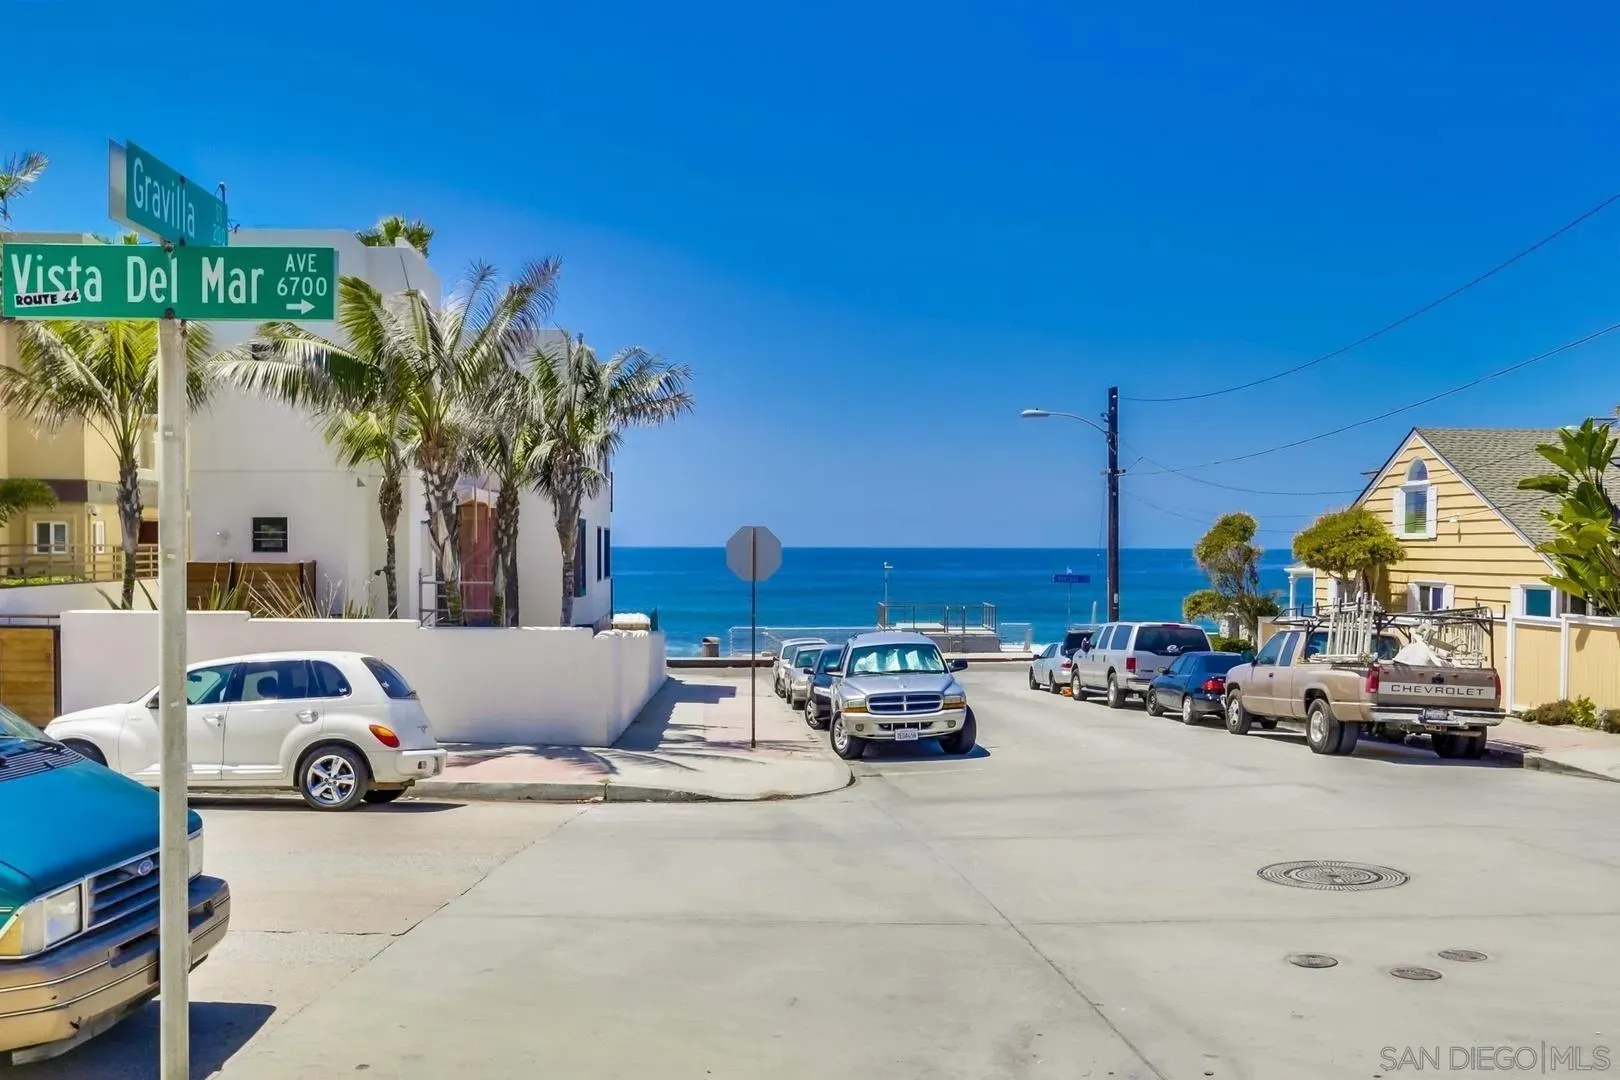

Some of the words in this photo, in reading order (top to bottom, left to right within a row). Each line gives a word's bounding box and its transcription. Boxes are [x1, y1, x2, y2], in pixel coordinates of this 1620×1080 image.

[133, 157, 195, 239] Gravilla
[284, 253, 317, 273] AVE
[10, 253, 102, 302] Vista
[126, 255, 178, 303] Del
[201, 256, 264, 304] Mar
[277, 277, 327, 297] 6700
[15, 294, 58, 306] ROUTE
[1391, 684, 1485, 696] CHEVROLET
